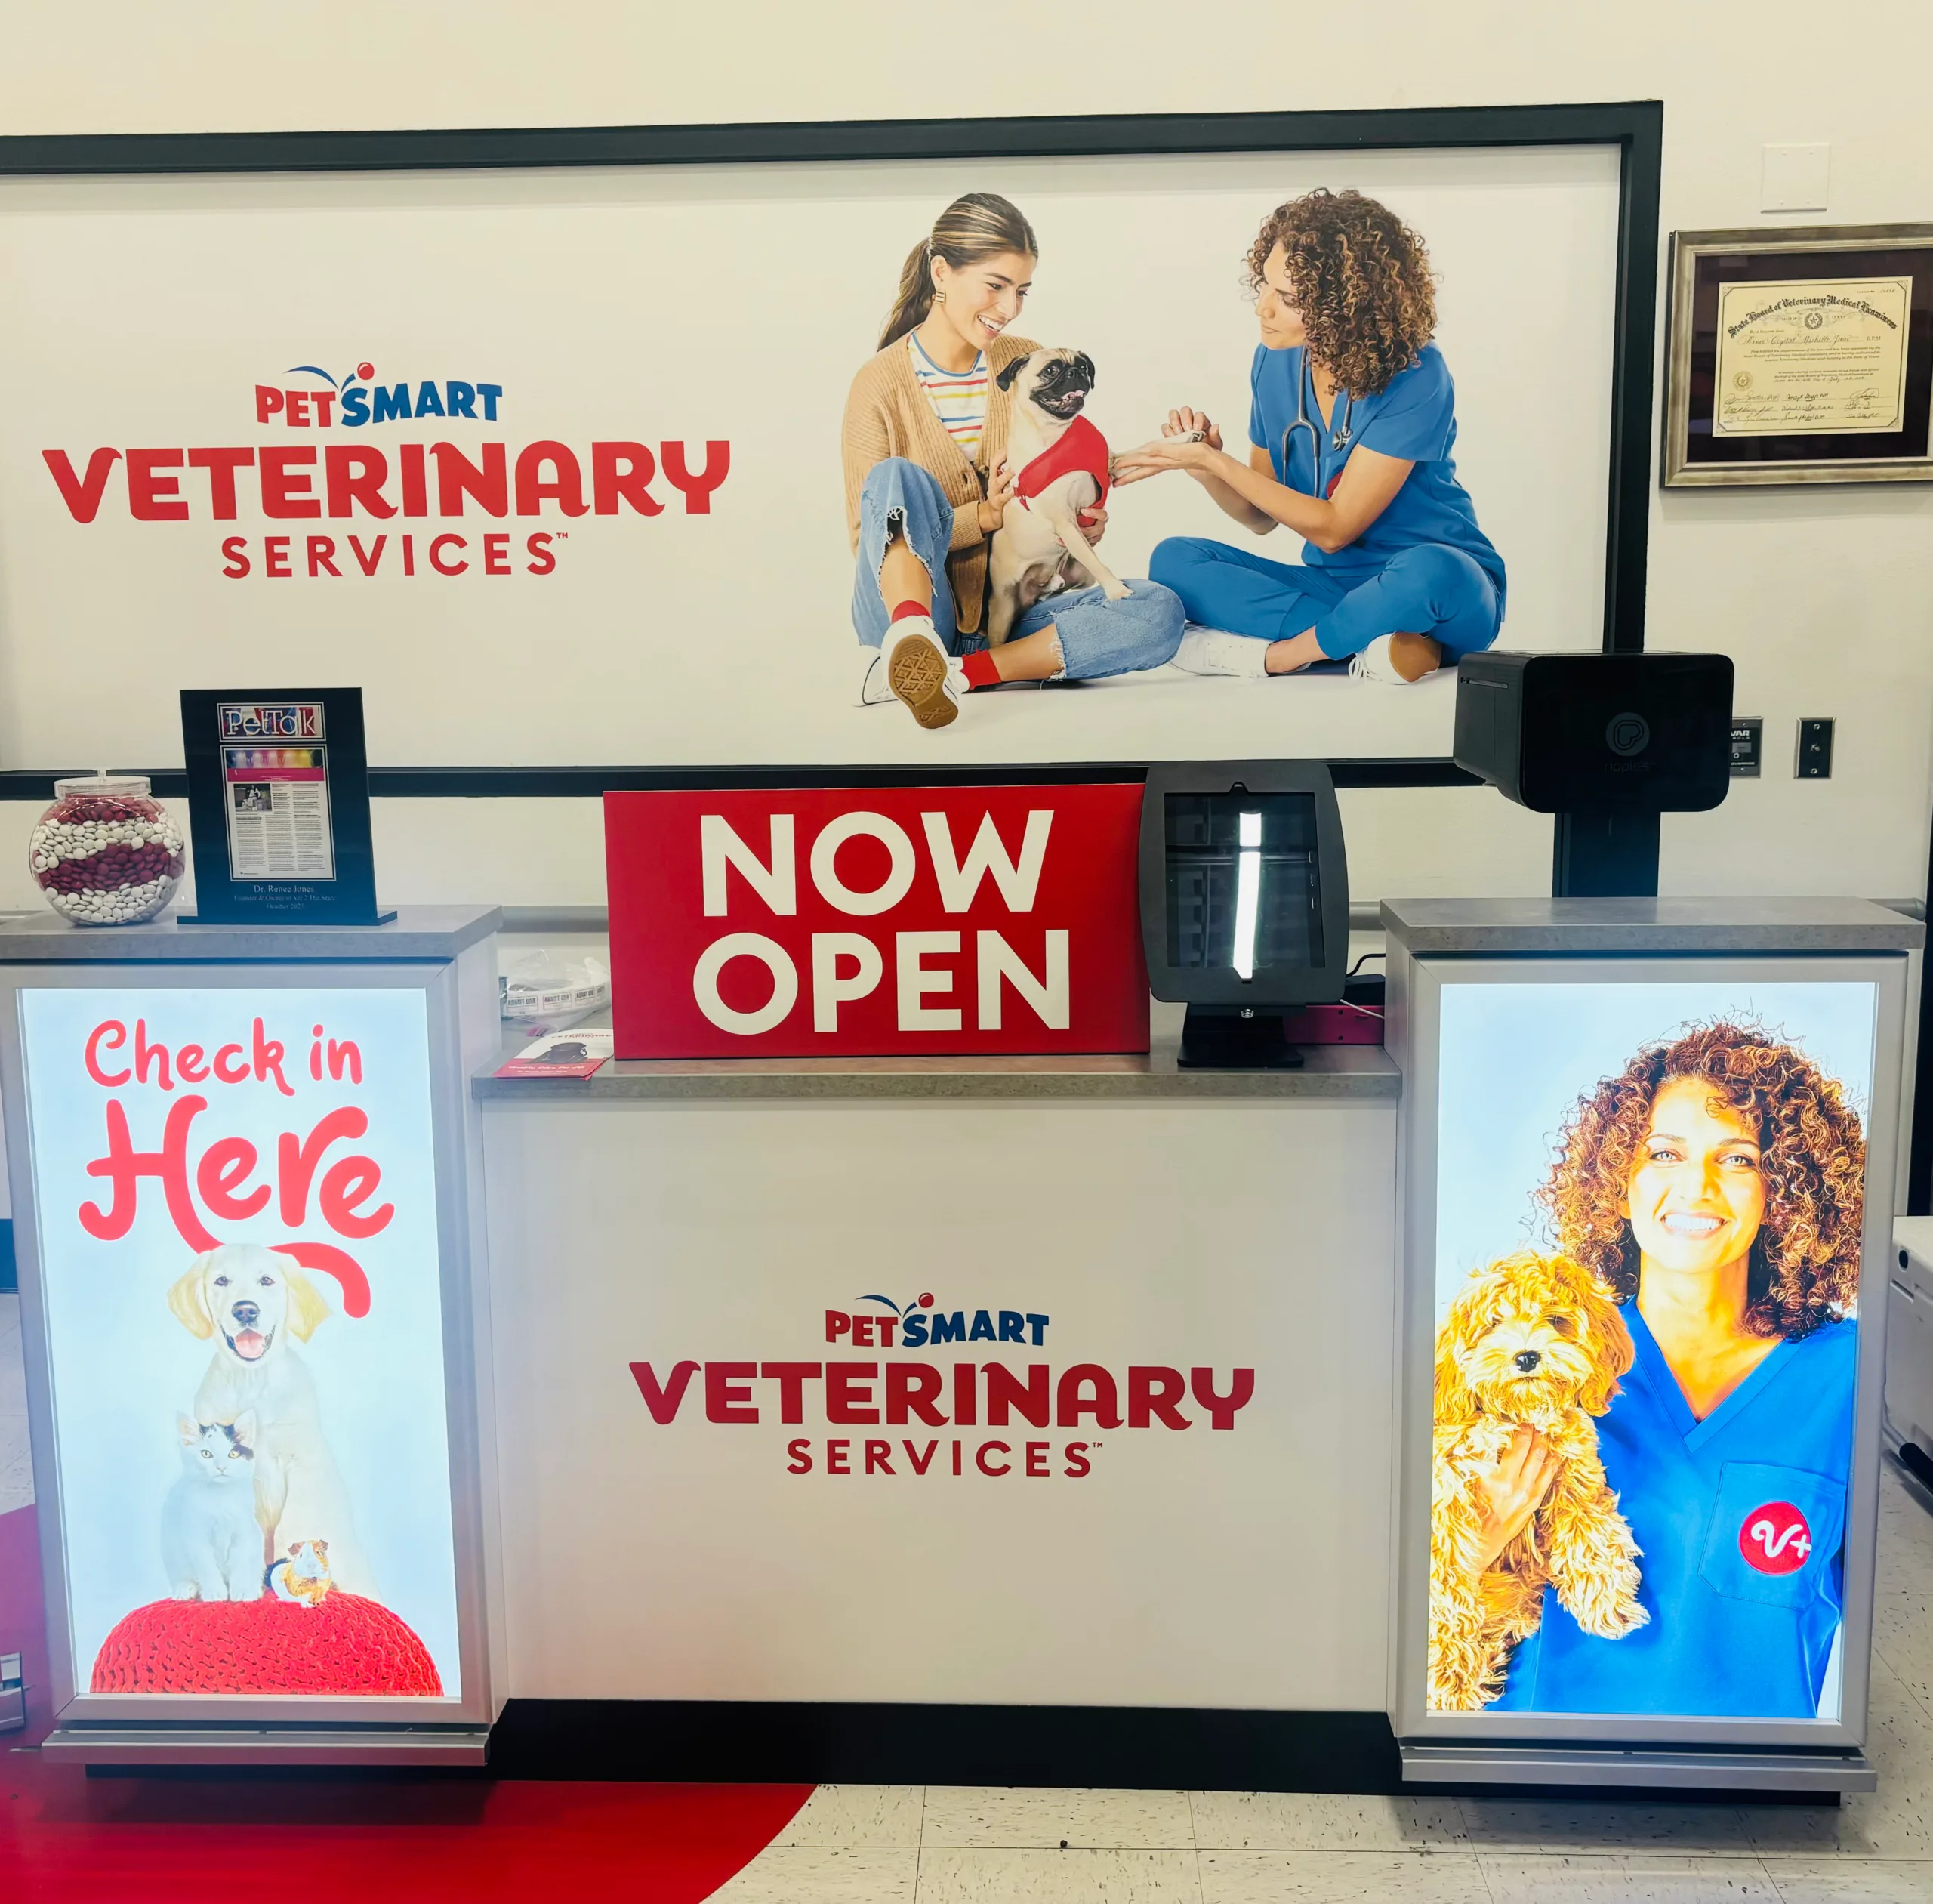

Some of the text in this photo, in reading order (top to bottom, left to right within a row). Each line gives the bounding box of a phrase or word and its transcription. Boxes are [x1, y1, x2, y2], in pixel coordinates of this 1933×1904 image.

[1728, 295, 1898, 339] State Board of Veterinary Medical Examiners
[255, 381, 502, 427] PETSMART
[42, 440, 730, 523] VETERINARY
[1604, 759, 1650, 773] ripples
[293, 884, 314, 893] Jones
[701, 810, 1054, 916] NOW
[693, 930, 1069, 1035] OPEN
[85, 1018, 362, 1099] Check in
[79, 1091, 394, 1317] Here
[826, 1309, 1048, 1347] PETSMART
[630, 1361, 1253, 1430] VETERINARY
